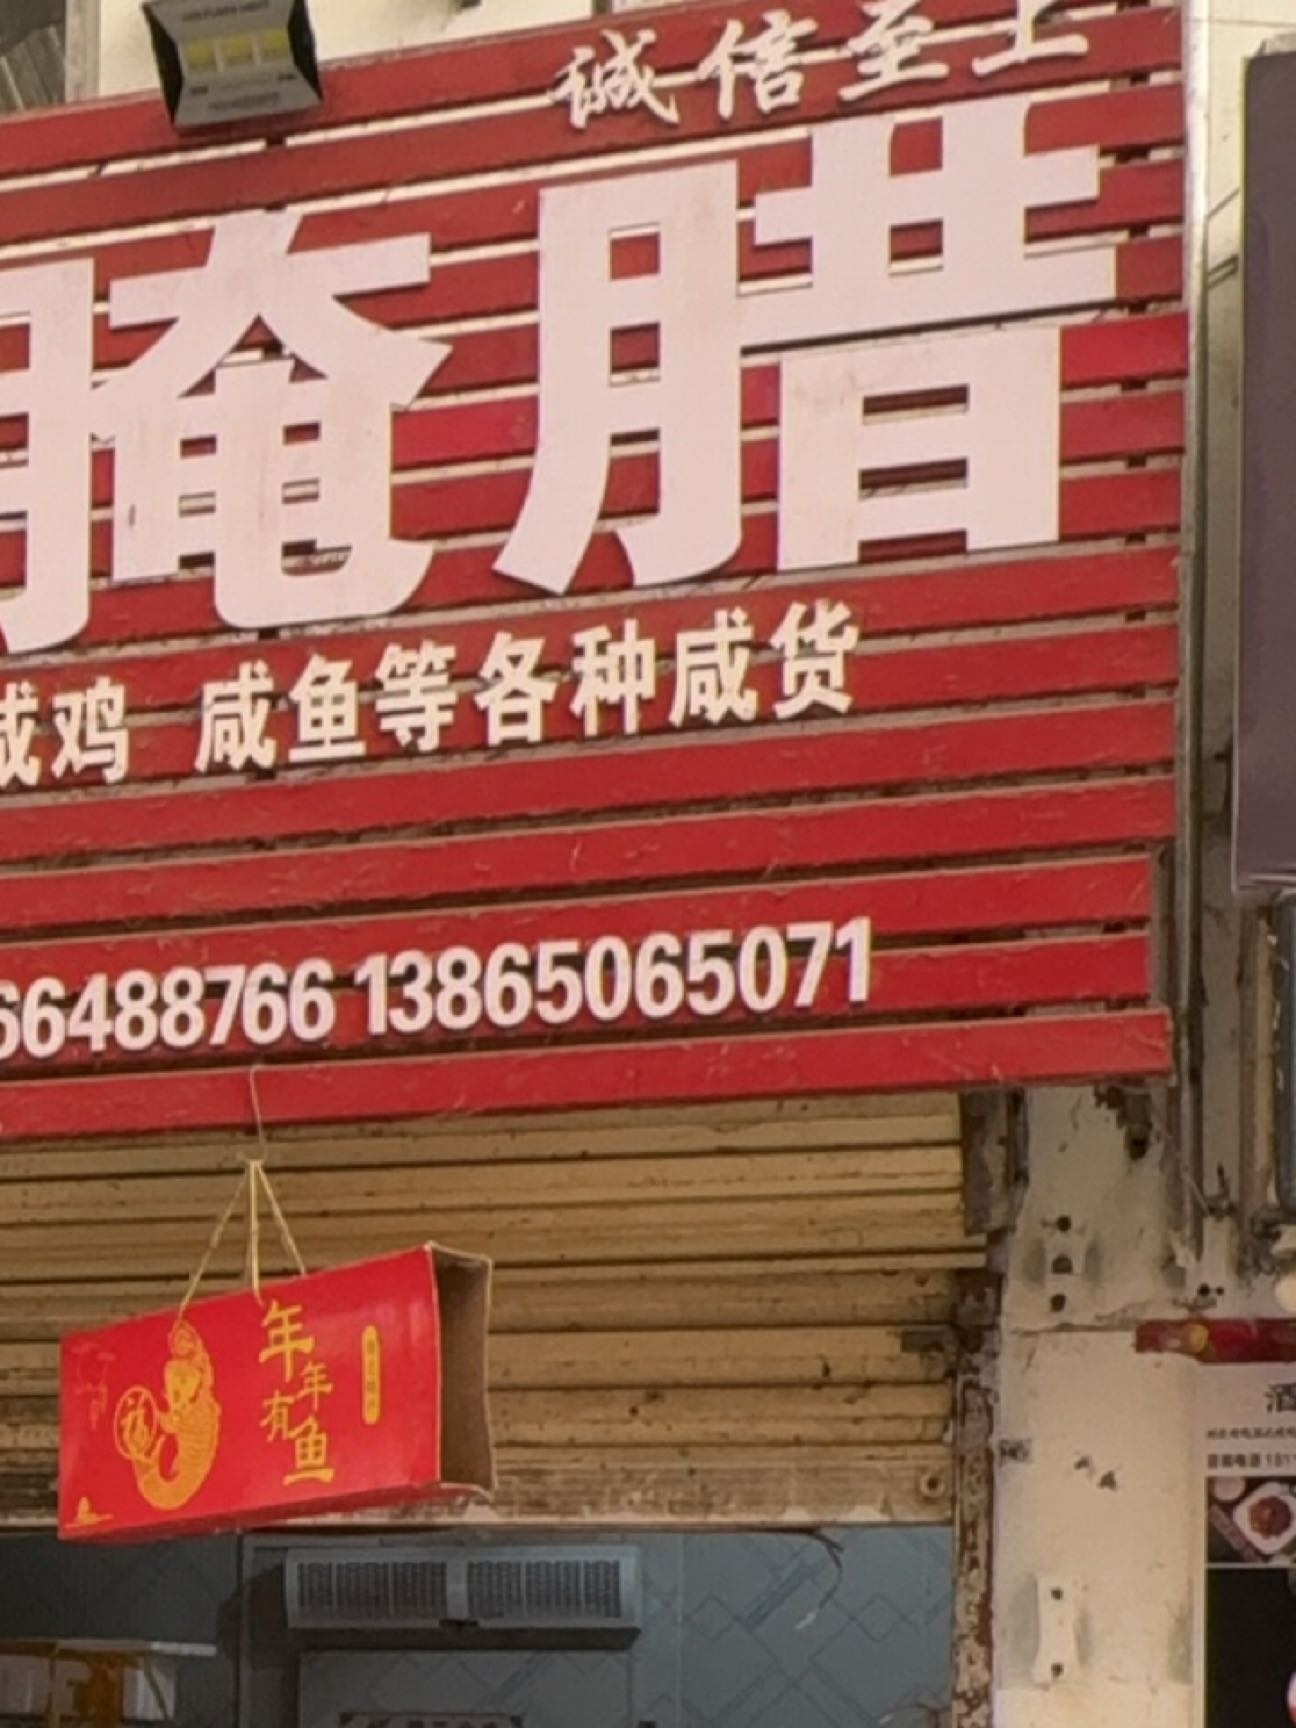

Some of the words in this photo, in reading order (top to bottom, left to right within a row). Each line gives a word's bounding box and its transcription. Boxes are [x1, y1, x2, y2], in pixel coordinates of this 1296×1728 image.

[194, 598, 861, 773] 咸鱼等各种咸货
[354, 916, 873, 1036] 13865065071
